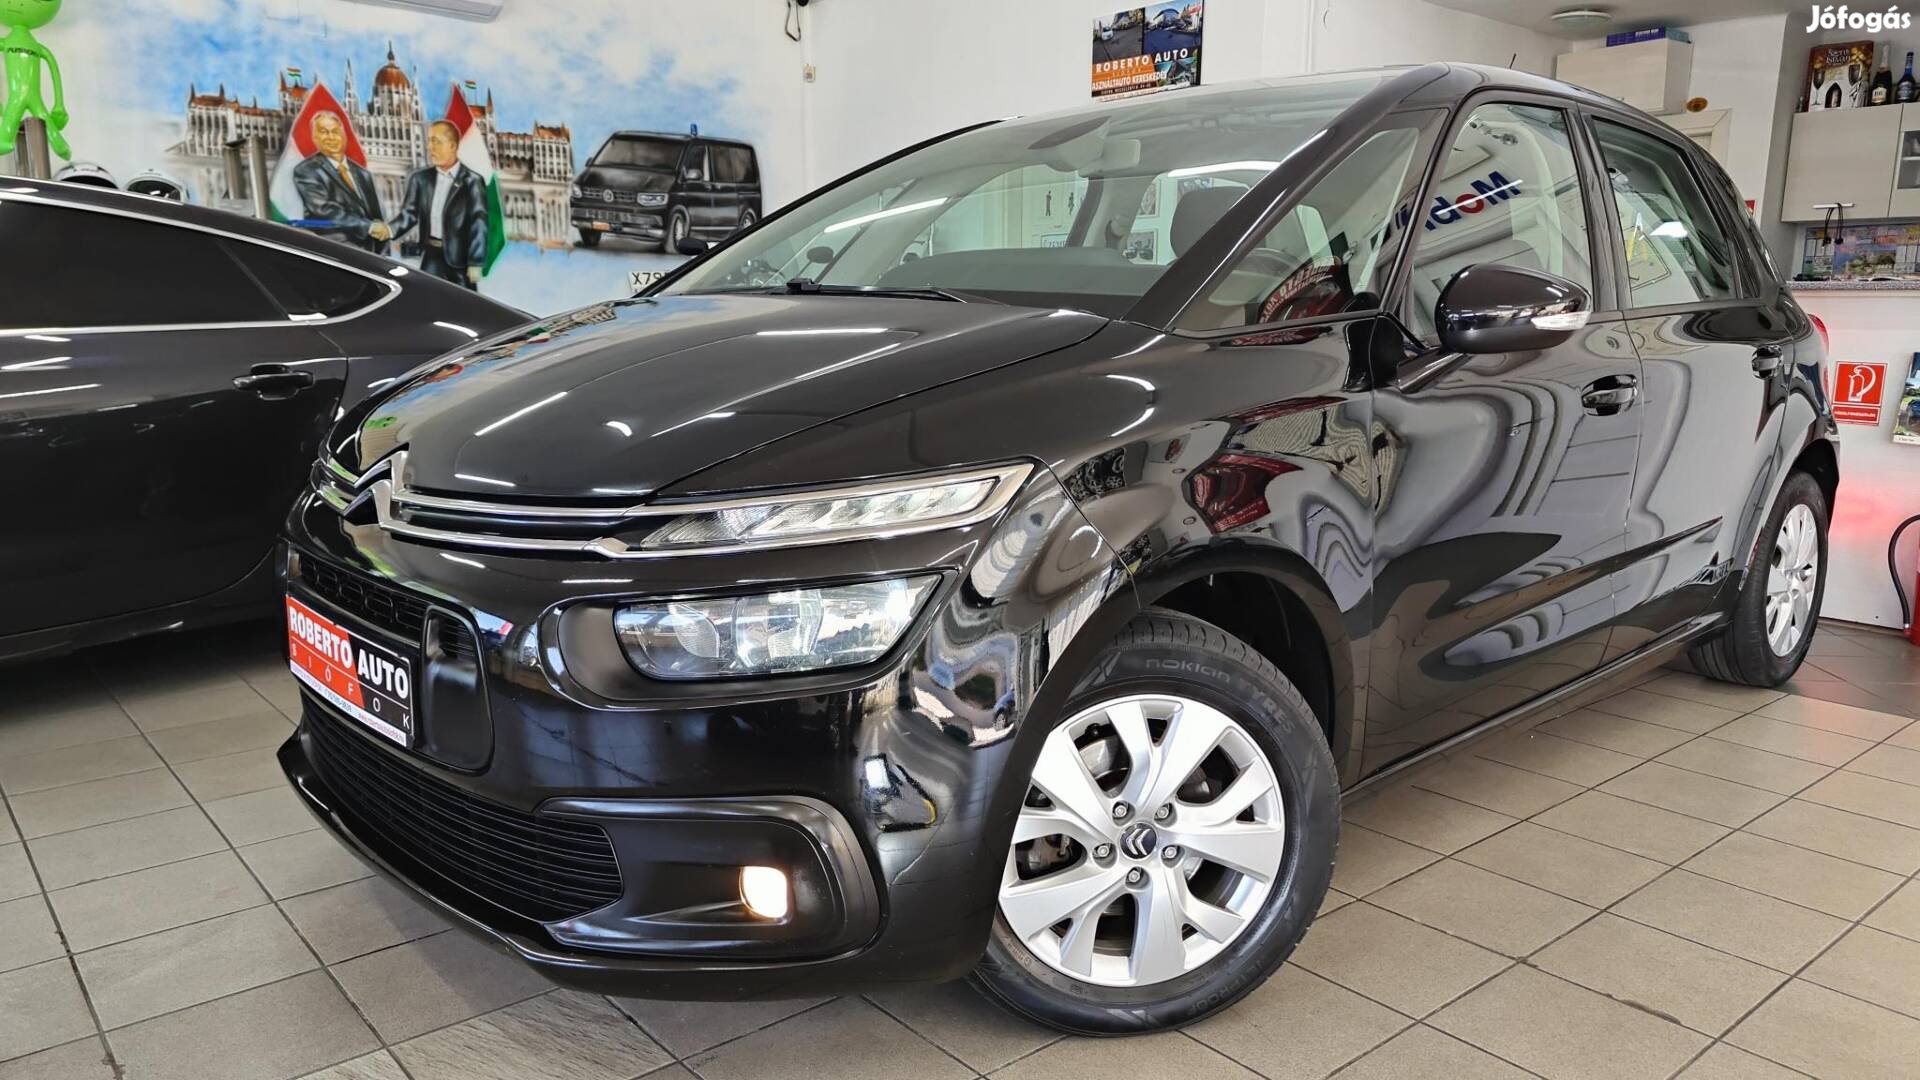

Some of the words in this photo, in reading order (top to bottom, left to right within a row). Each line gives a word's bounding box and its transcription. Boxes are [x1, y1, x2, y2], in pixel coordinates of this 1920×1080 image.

[1096, 55, 1150, 73] ROBERTO
[1155, 48, 1188, 63] AUTO
[289, 606, 353, 669] ROBERTO
[358, 648, 409, 699] AUTO
